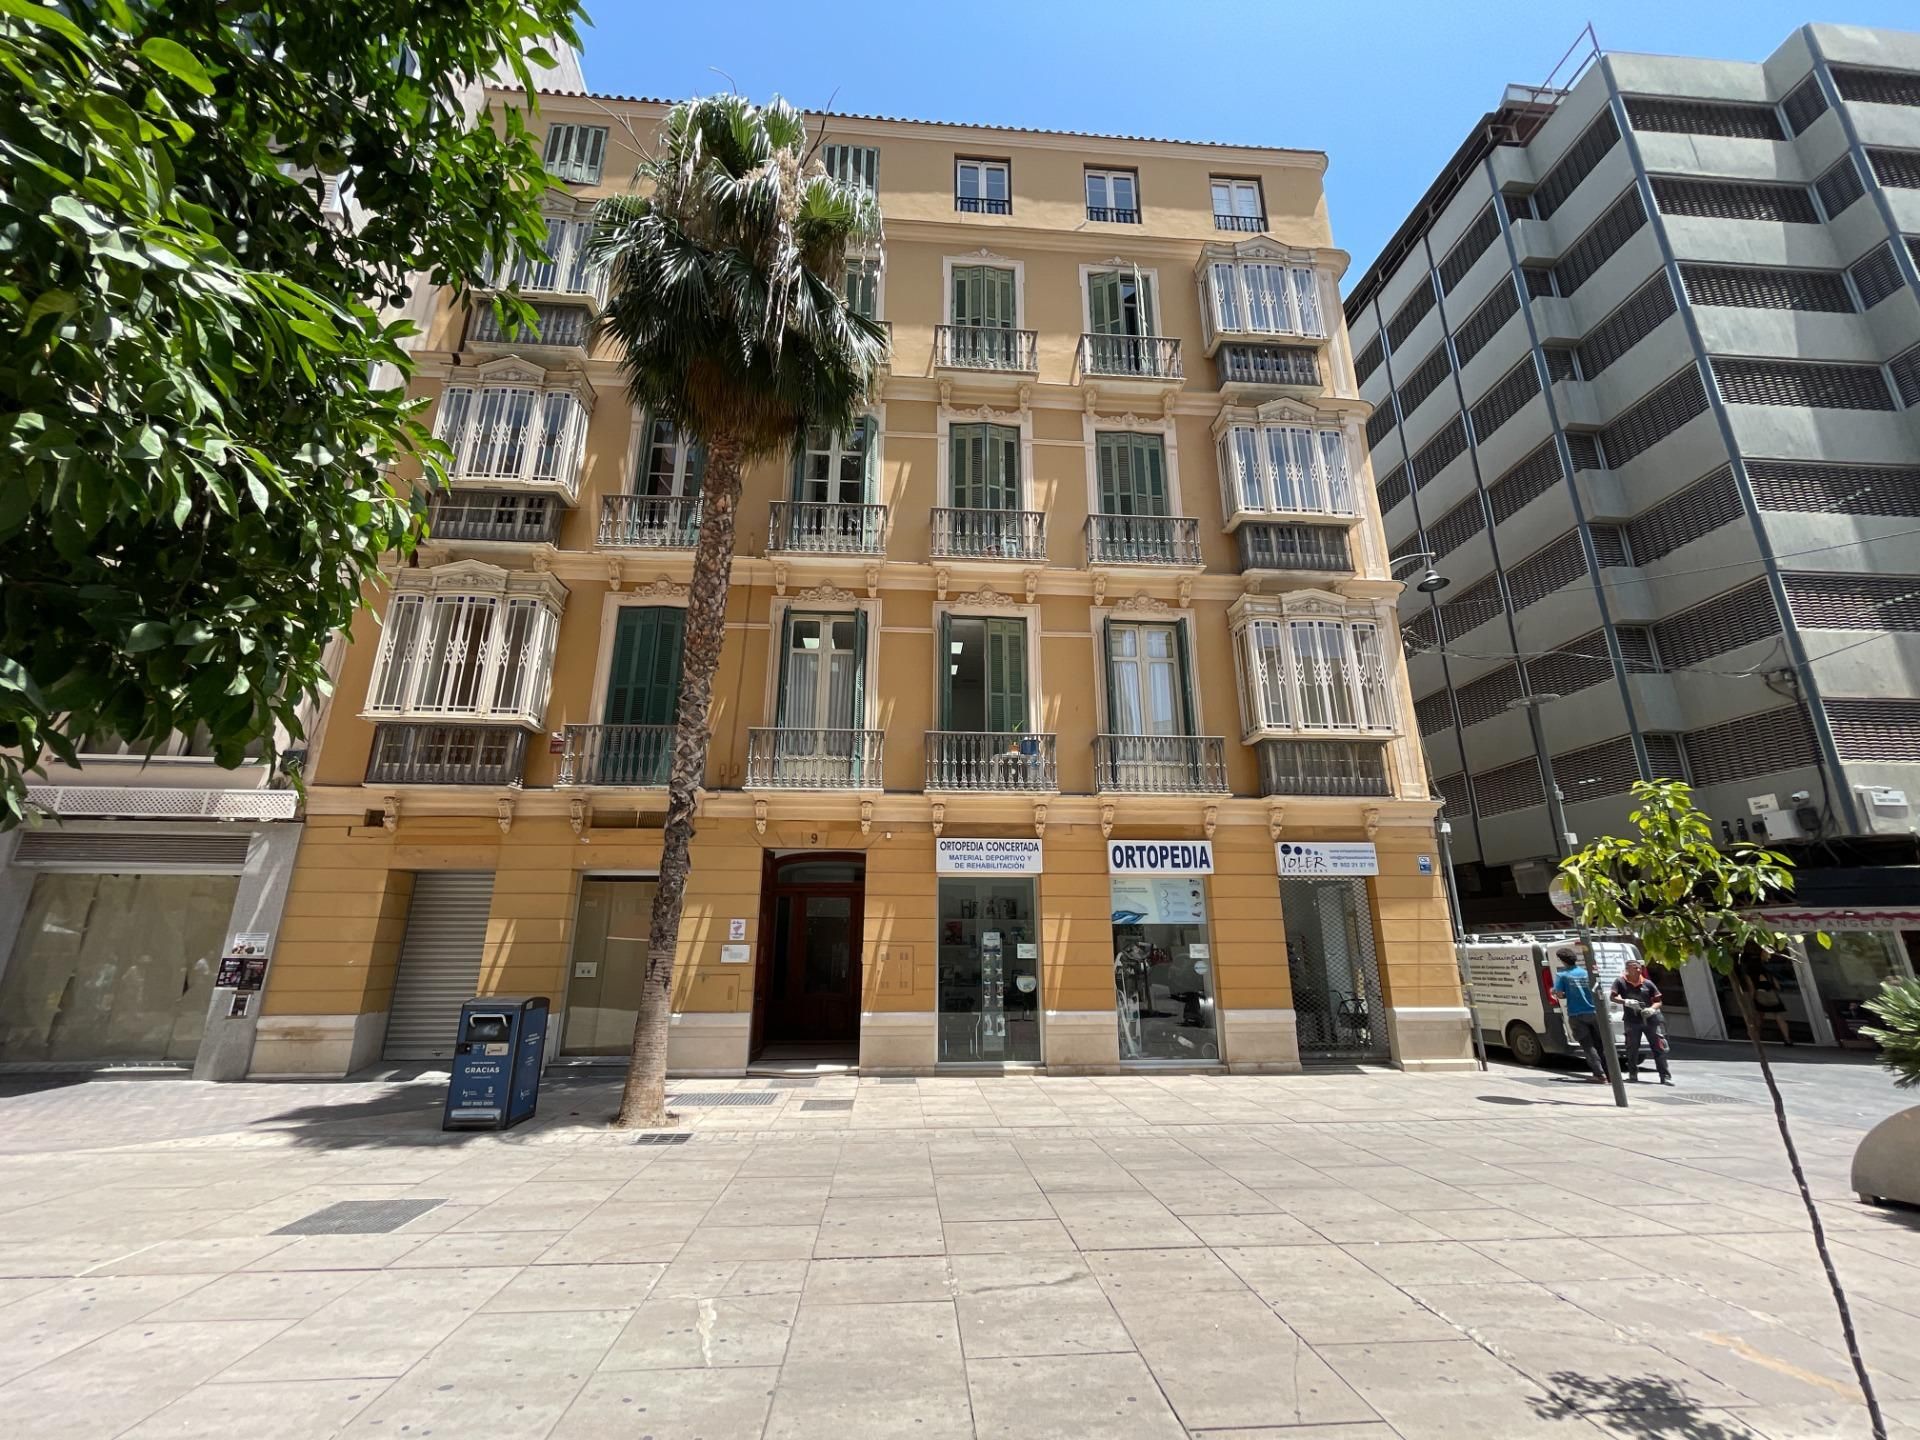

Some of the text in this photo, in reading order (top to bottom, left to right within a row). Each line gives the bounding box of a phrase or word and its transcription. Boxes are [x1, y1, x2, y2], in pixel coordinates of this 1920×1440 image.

[811, 833, 818, 844] 9
[940, 841, 1039, 852] ORTOPEDIA CONCERTADA
[1112, 845, 1211, 869] ORTOPEDIA
[966, 862, 1025, 870] REHABILITACIÓN
